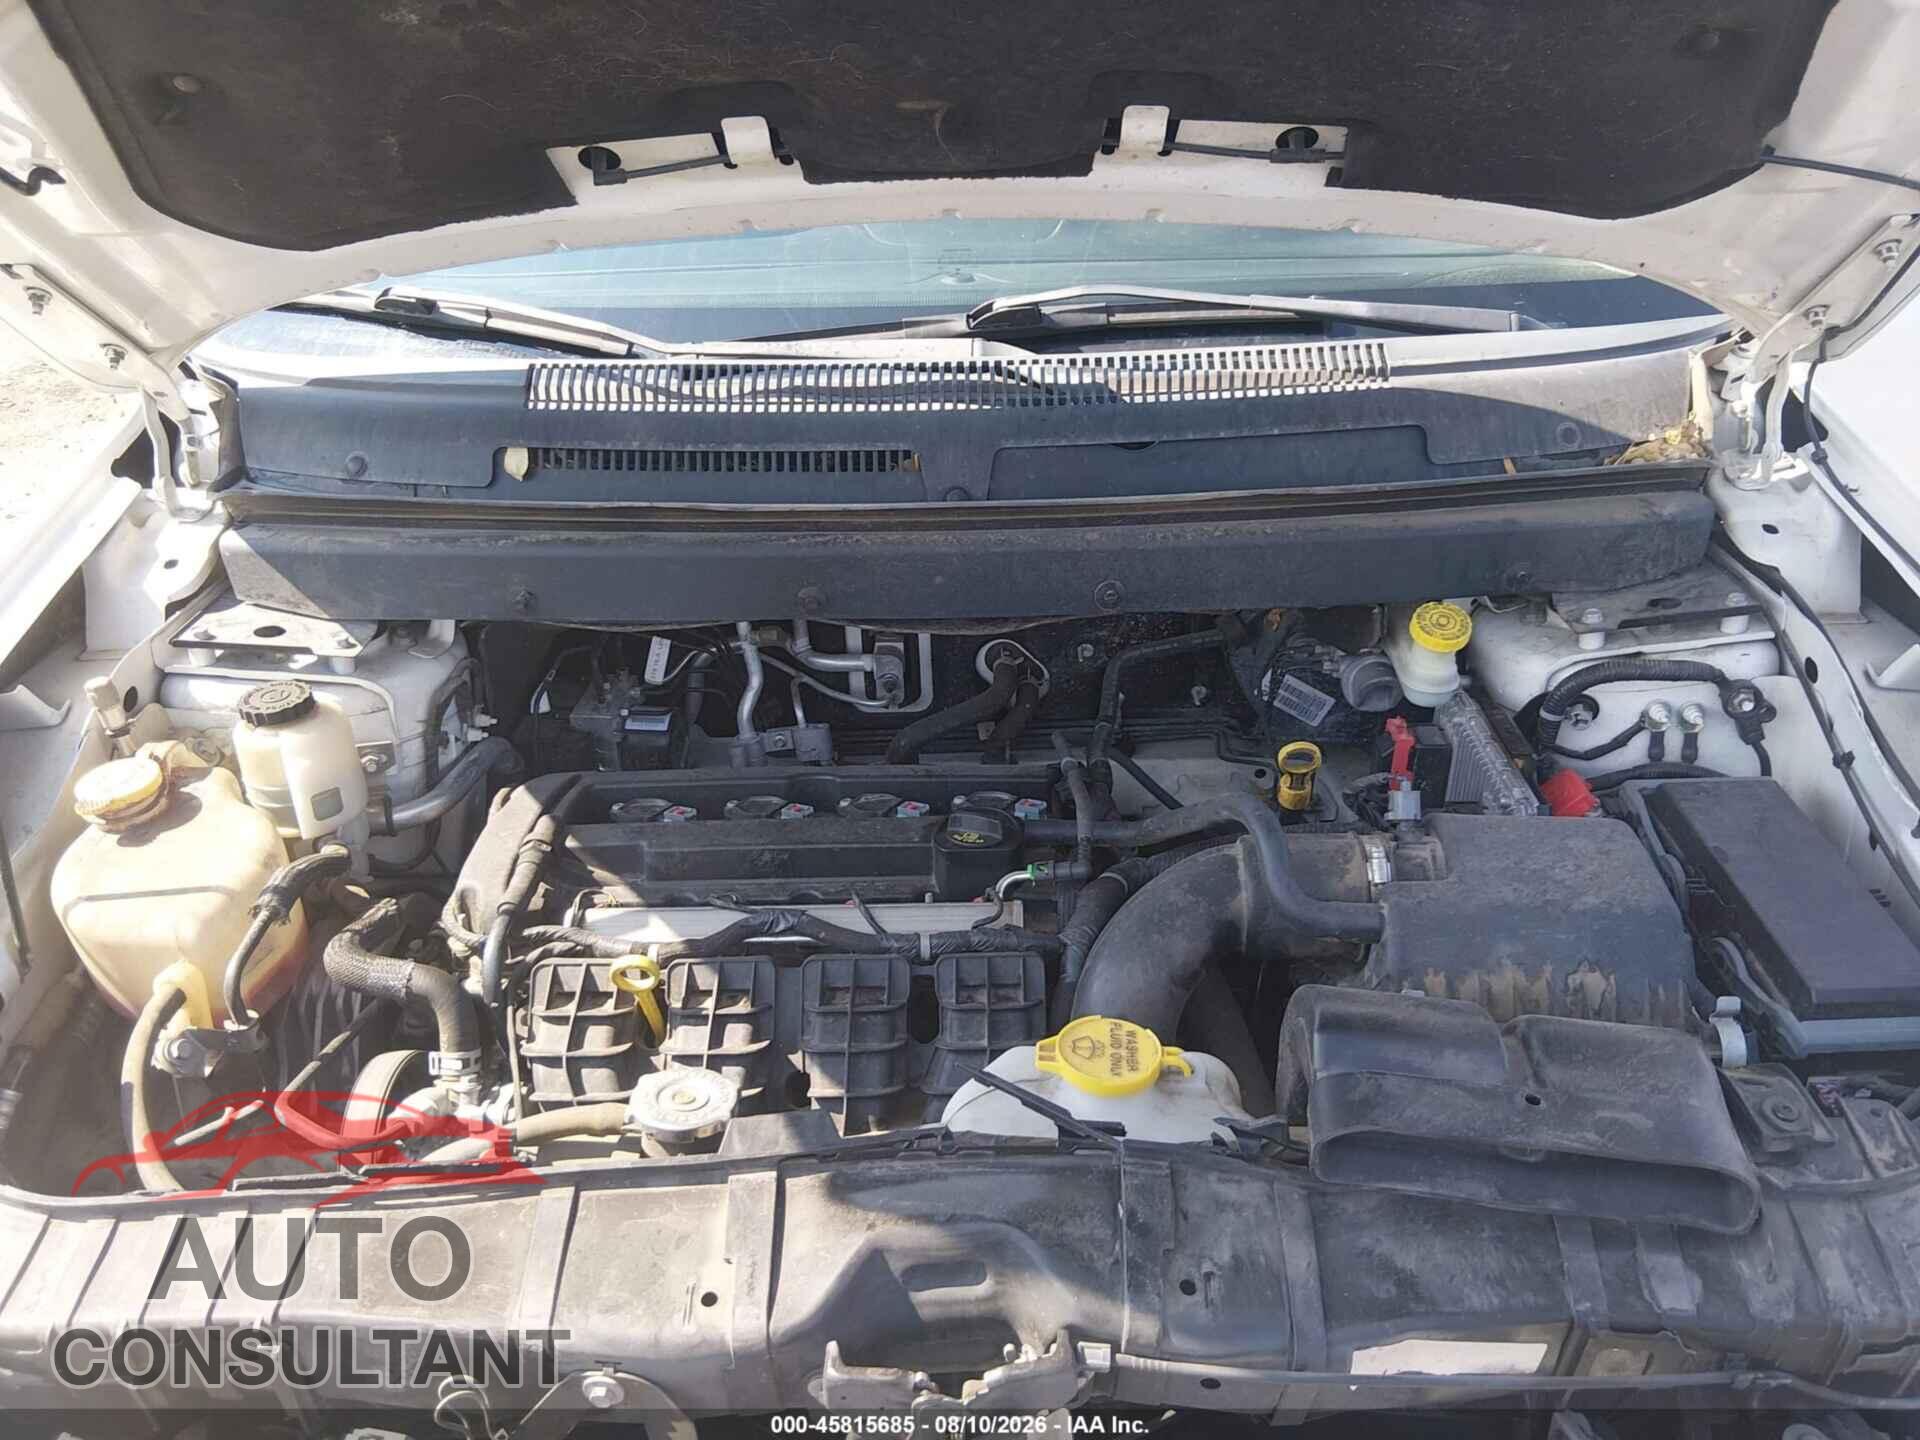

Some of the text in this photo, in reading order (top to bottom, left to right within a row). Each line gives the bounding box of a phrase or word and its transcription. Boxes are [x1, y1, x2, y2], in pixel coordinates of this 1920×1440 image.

[1110, 1022, 1121, 1077] FLUID ONLY
[1126, 1030, 1138, 1072] WASHER
